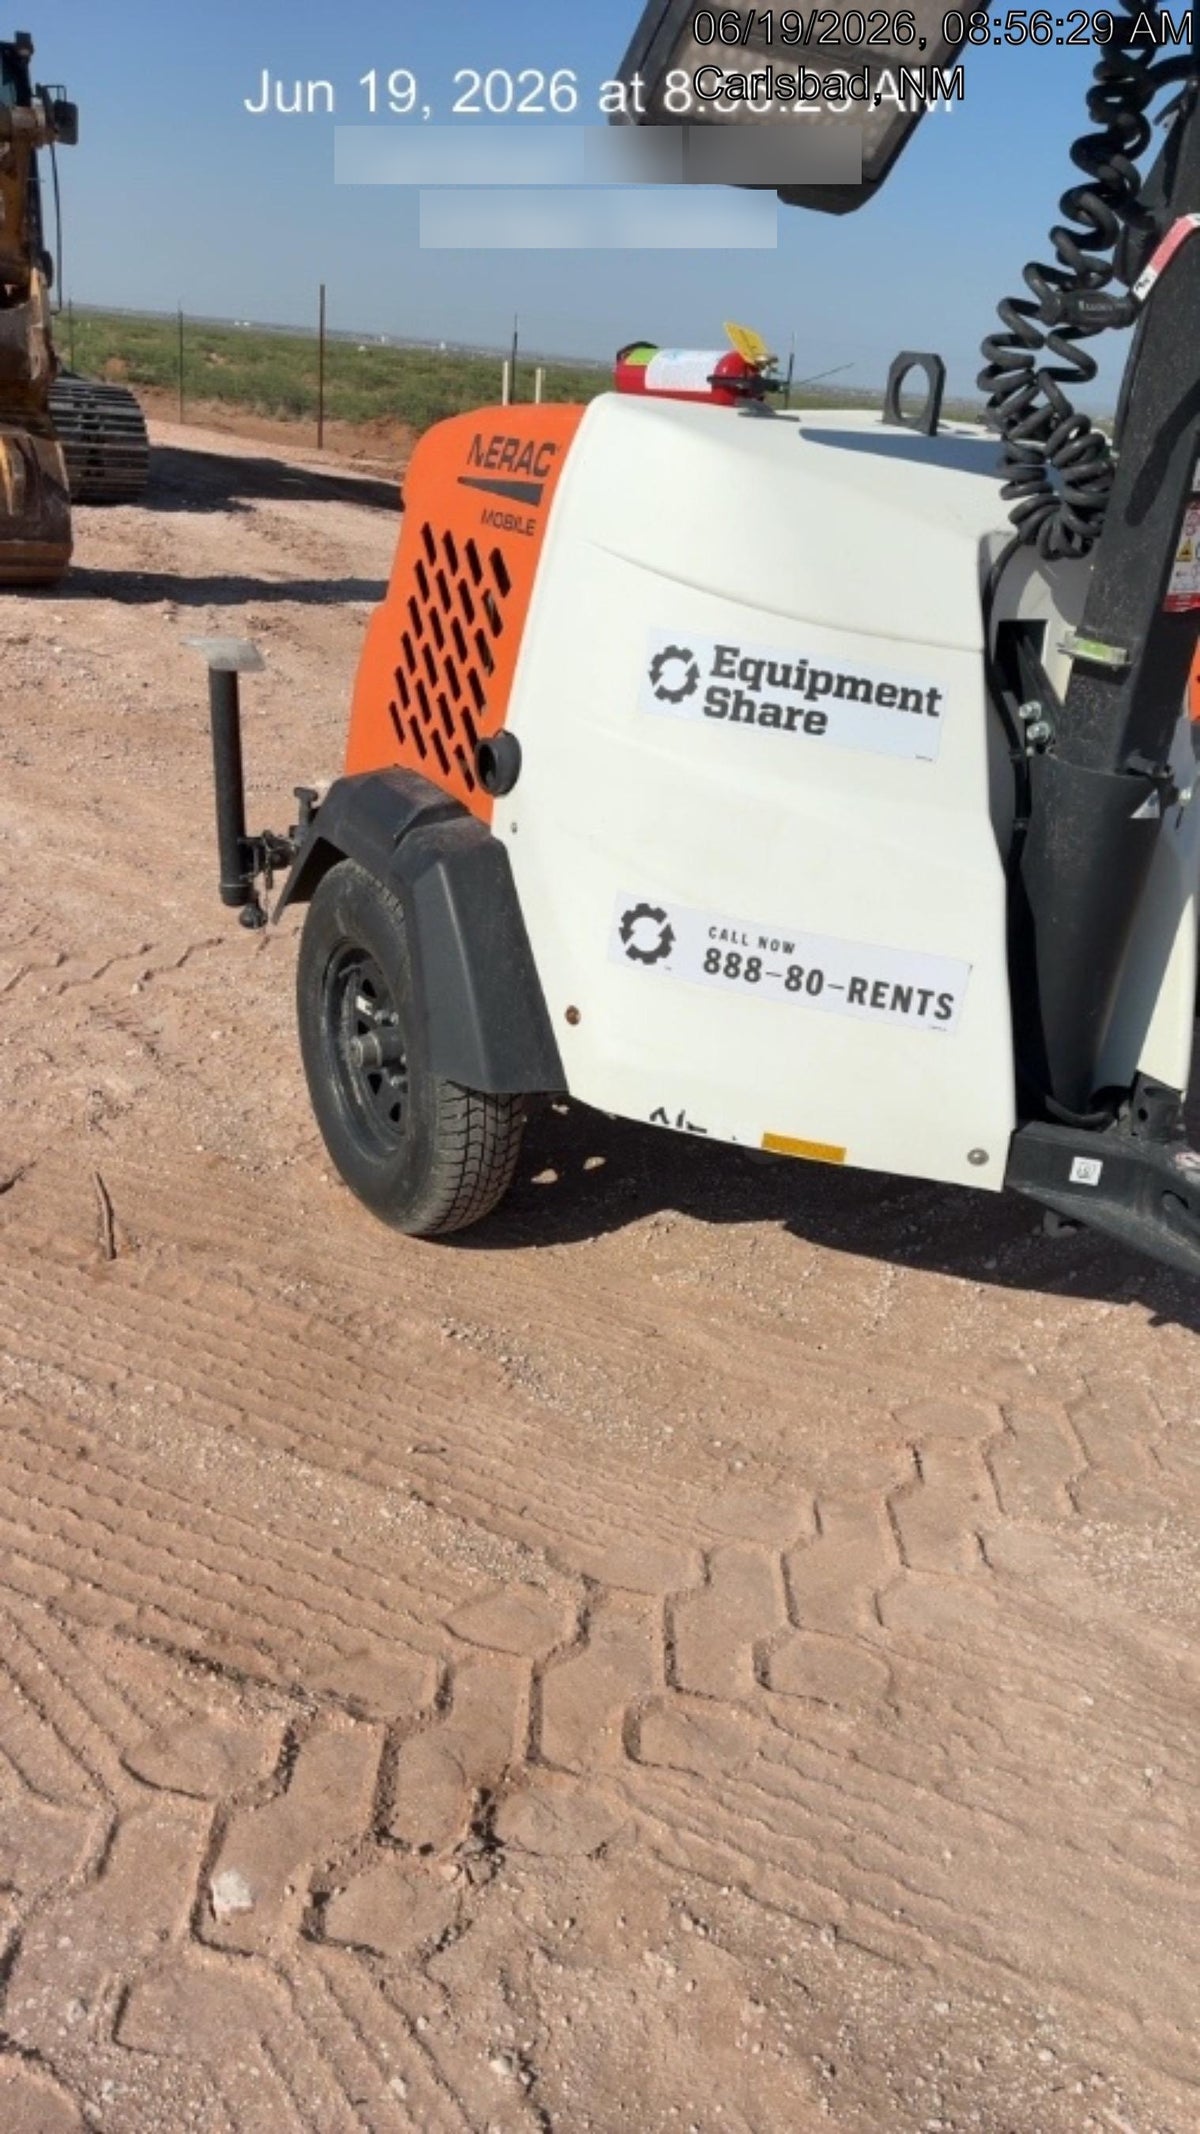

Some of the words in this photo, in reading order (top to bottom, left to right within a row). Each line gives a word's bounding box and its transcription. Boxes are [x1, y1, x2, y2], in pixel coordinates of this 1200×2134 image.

[480, 509, 537, 537] MOBILE
[709, 644, 943, 717] Equipment
[703, 685, 829, 736] Share
[708, 925, 749, 947] CALL
[758, 935, 796, 955] NOW
[703, 946, 954, 1021] 888-80-RENTS
